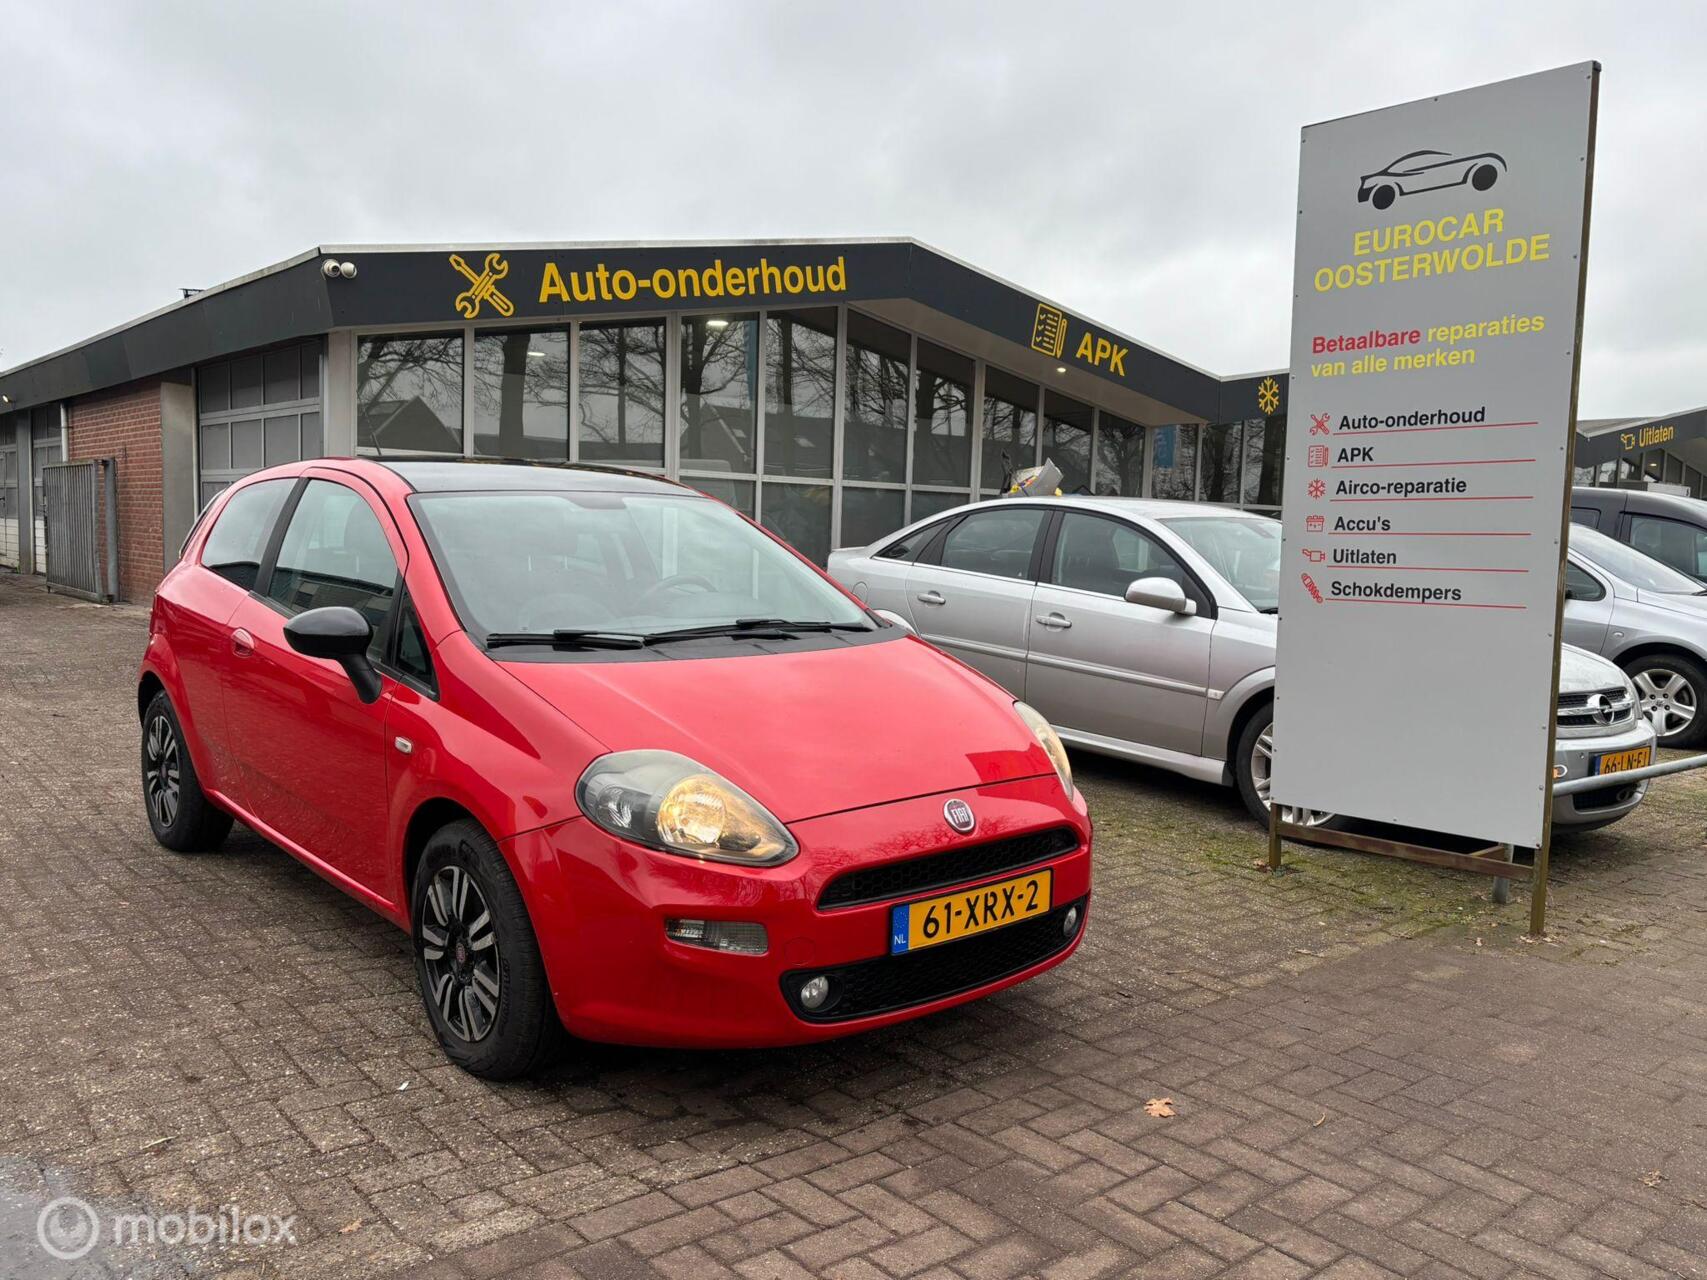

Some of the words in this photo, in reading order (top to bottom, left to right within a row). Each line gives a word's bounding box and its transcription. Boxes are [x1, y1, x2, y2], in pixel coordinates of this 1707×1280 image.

[1353, 207, 1505, 256] EUROCAR
[1313, 233, 1551, 292] OOSTERWOLDE
[538, 255, 847, 304] Auto-onderhoud
[1311, 328, 1421, 354] Betaalbare
[1427, 315, 1546, 346] reparaties
[1075, 332, 1129, 377] APK
[1311, 361, 1346, 378] van
[1351, 352, 1388, 375] alle
[1393, 346, 1476, 370] merken
[1338, 406, 1486, 431] Auto-onderhoud
[1638, 425, 1675, 448] Uitlaten
[1337, 446, 1374, 463] APK
[1335, 477, 1467, 498] Airco-reparatie
[1334, 516, 1391, 532] Accu's
[1332, 548, 1397, 565] Uitlaten
[1331, 580, 1462, 603] Schokdempers
[950, 807, 970, 824] FIAT
[893, 934, 906, 945] NL
[923, 880, 1039, 939] 61-XRX-2
